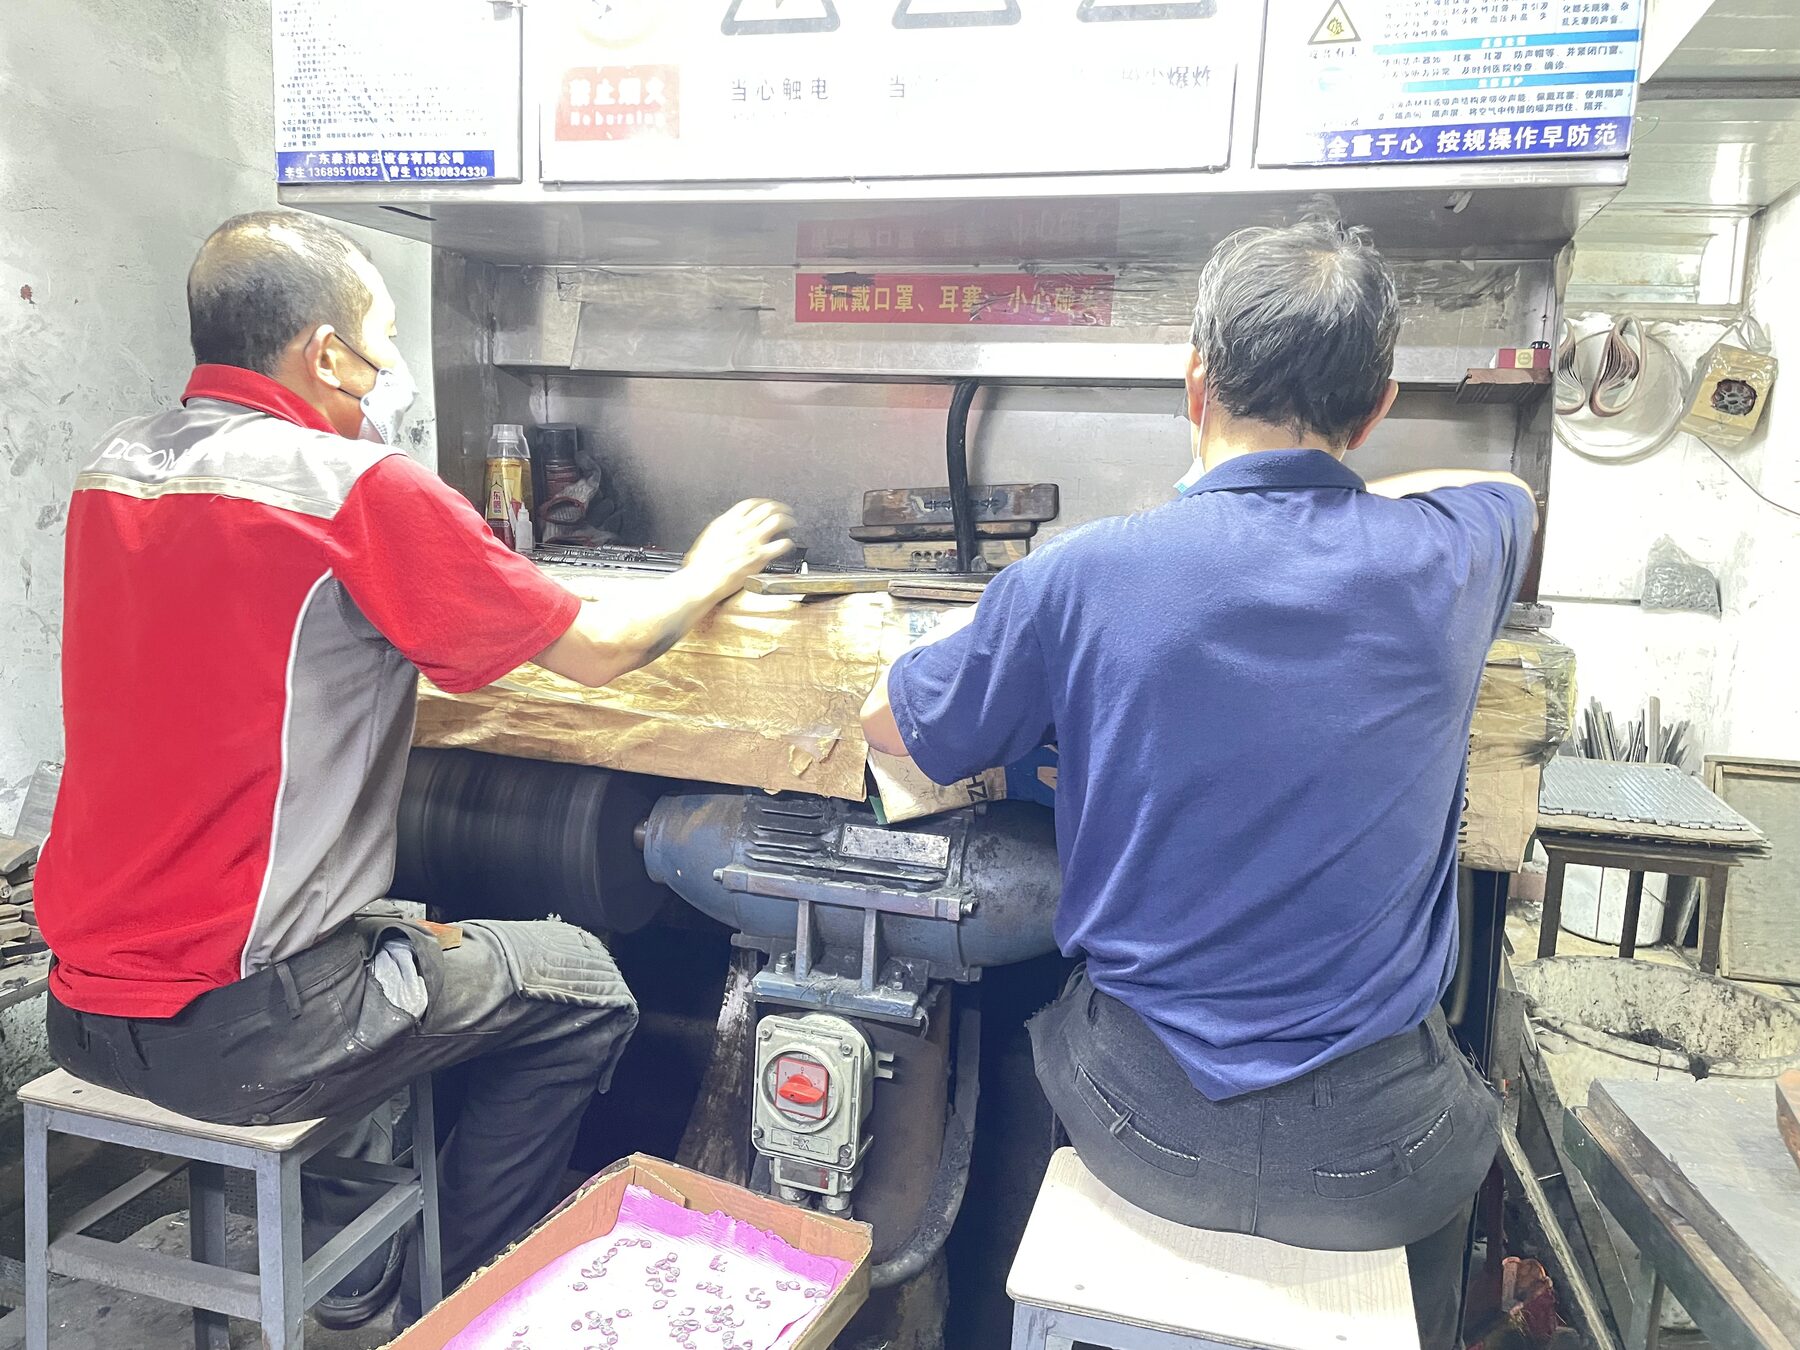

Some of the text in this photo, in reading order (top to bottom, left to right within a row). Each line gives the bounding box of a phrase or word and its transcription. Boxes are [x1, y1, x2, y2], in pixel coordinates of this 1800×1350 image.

[731, 77, 829, 102] 当心触电
[1437, 122, 1618, 153] 按规操作早防范
[309, 166, 378, 178] 13689510832
[414, 165, 488, 178] 13580834330
